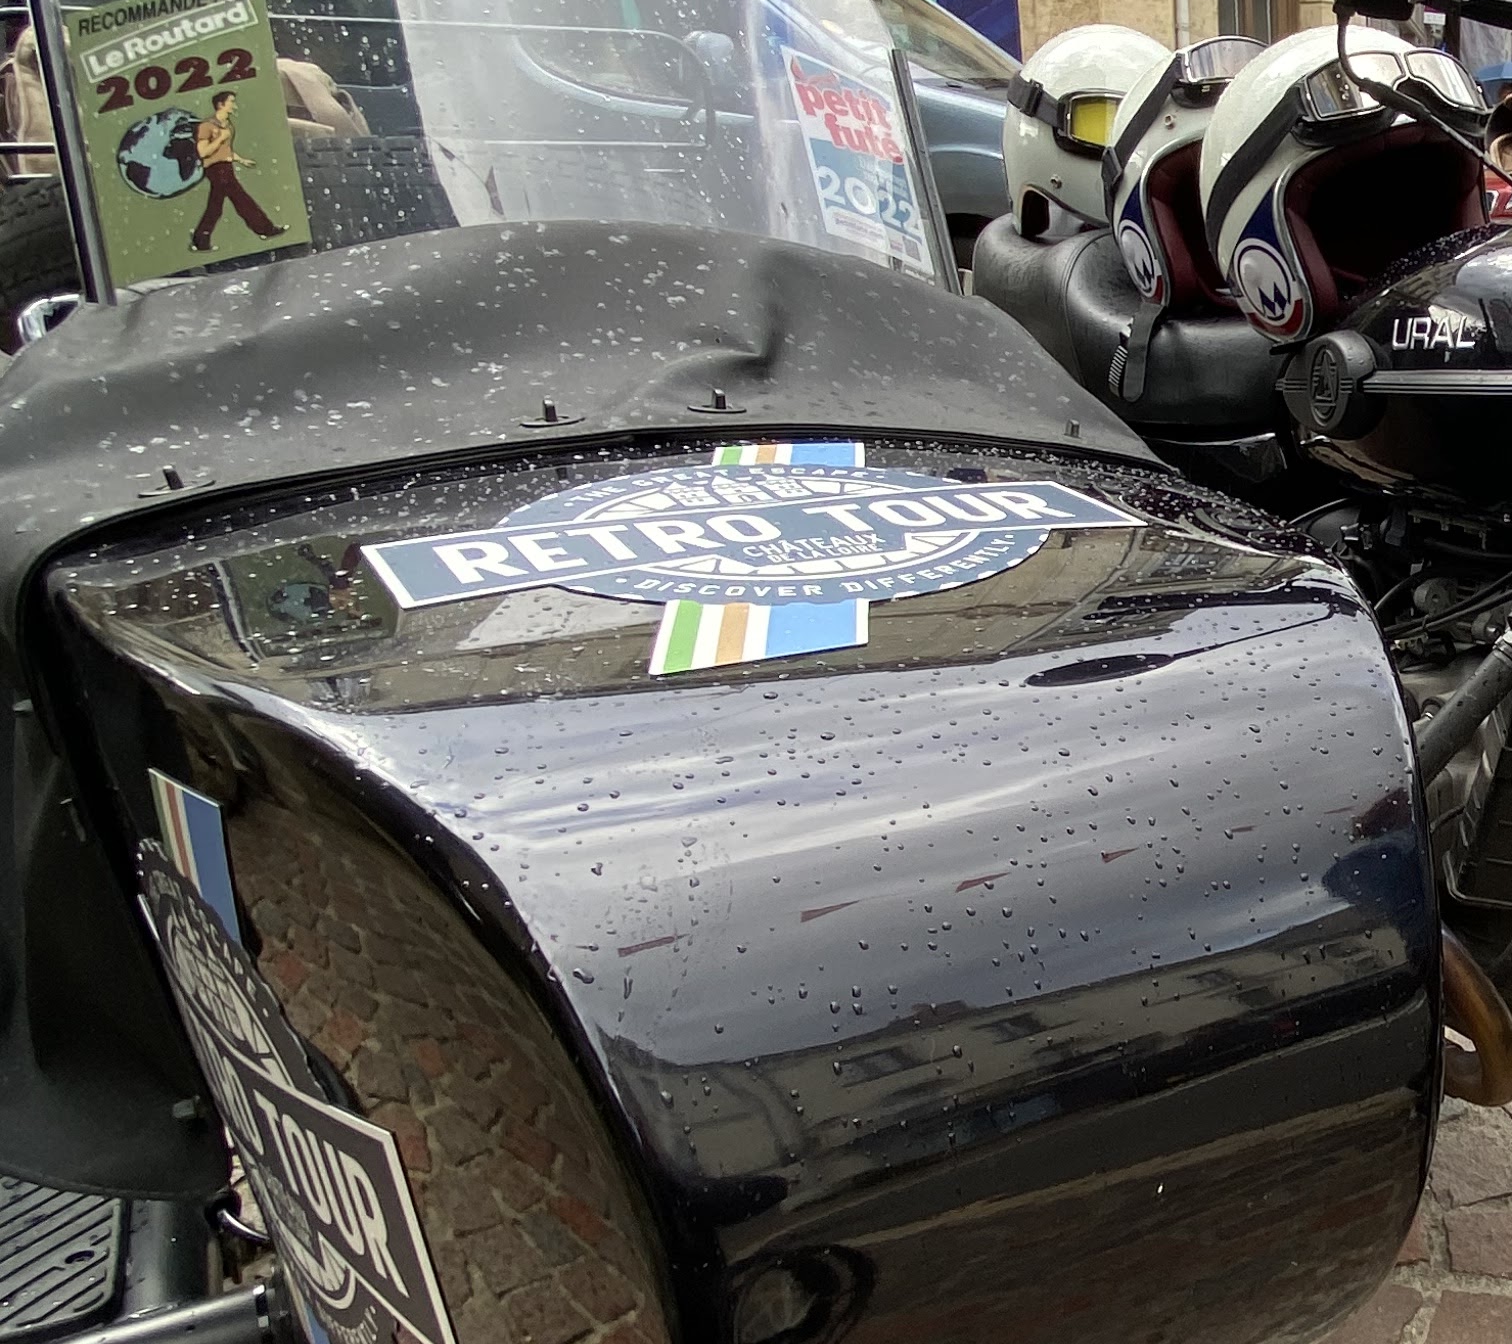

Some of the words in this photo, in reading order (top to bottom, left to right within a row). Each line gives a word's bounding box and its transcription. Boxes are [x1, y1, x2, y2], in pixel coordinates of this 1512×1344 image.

[122, 2, 250, 61] Routard
[96, 48, 257, 114] 2022
[795, 82, 893, 131] petit
[824, 113, 904, 164] futé
[816, 165, 920, 231] 2022
[1392, 315, 1476, 350] URAL
[434, 513, 781, 584] RETRO
[802, 491, 1074, 532] TOUR
[634, 578, 824, 598] DISCOVER
[842, 536, 1008, 594] DIFFERENTLY
[743, 533, 887, 558] CHÂTEAUX
[794, 548, 825, 562] LA
[826, 542, 883, 559] LOIRE
[253, 1087, 410, 1299] TOUR
